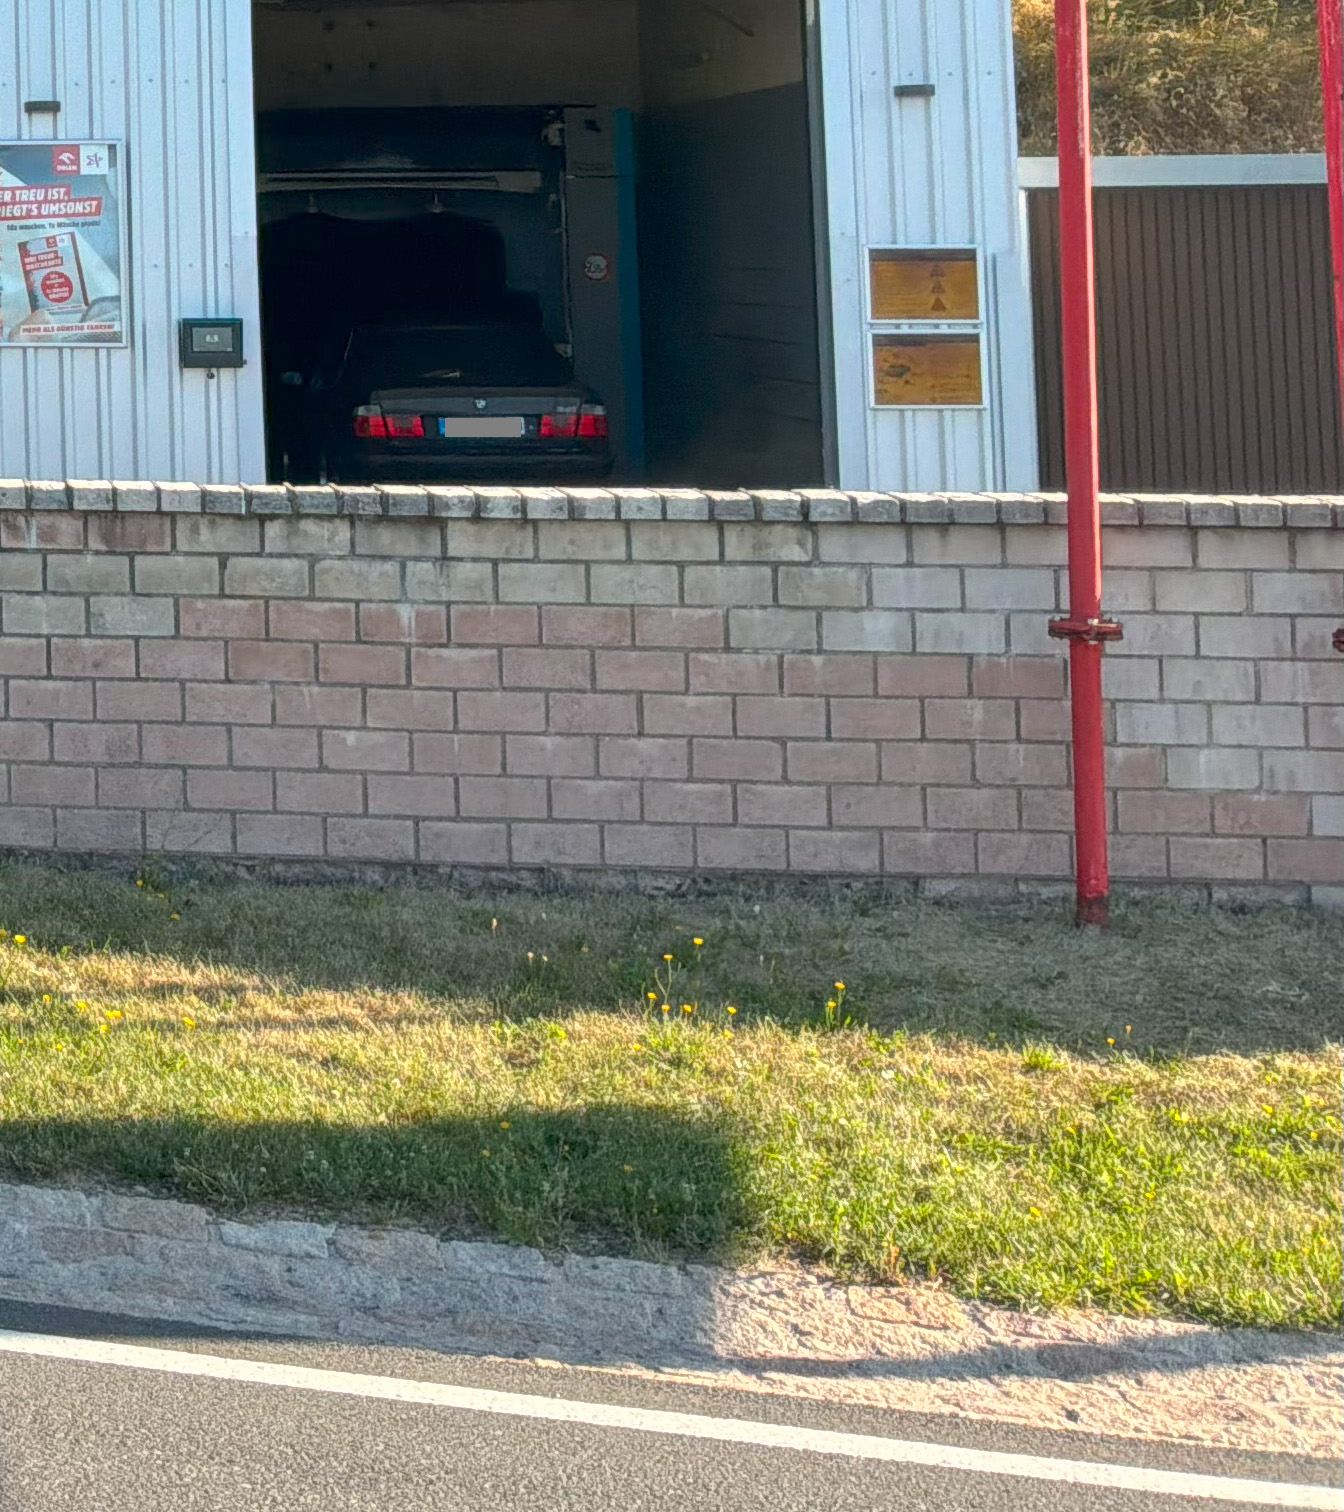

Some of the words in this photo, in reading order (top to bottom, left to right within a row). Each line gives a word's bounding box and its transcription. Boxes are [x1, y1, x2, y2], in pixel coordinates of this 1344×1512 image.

[15, 190, 46, 202] TREU
[48, 188, 69, 201] IST,
[41, 201, 98, 216] UMSONST
